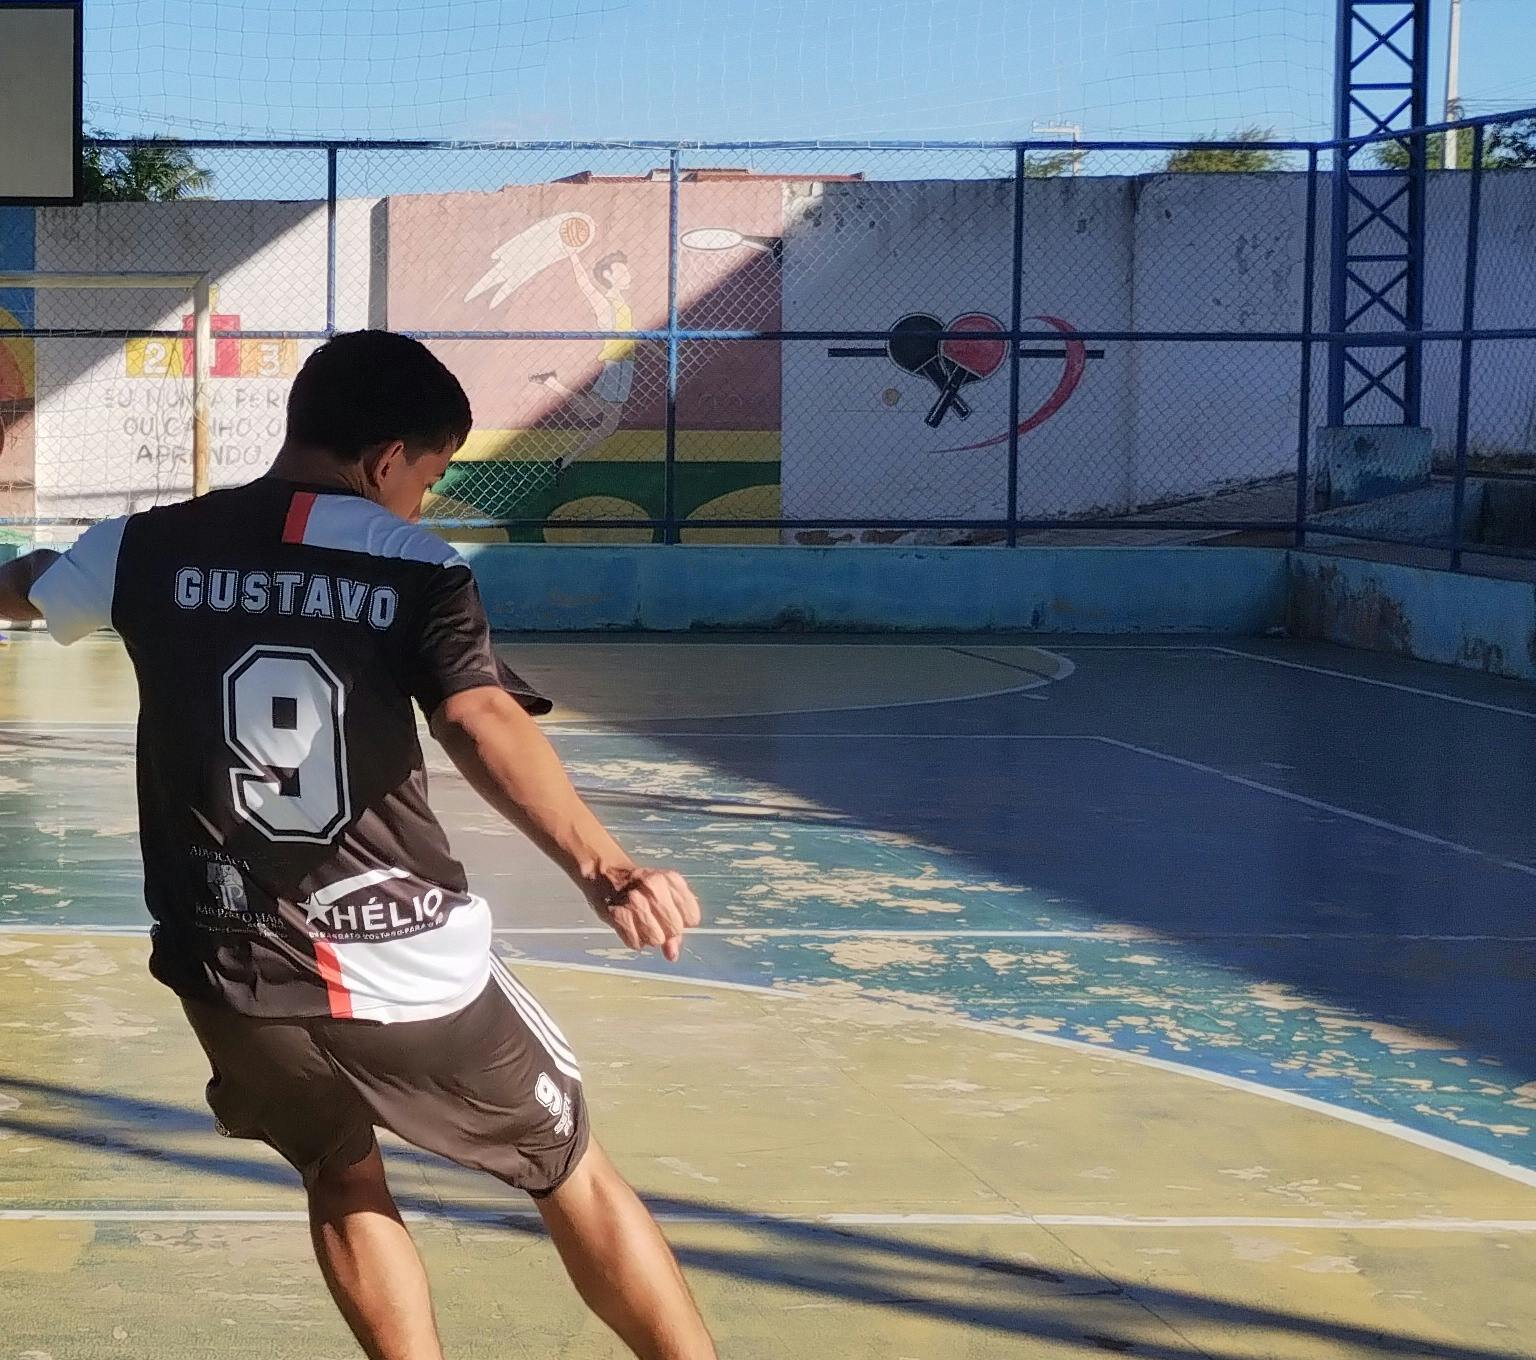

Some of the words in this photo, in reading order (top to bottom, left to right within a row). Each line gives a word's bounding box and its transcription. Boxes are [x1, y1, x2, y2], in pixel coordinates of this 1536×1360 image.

[144, 342, 168, 374] 2
[257, 342, 281, 377] 3
[105, 389, 132, 408] EU
[147, 389, 222, 408] NUNA
[123, 417, 154, 436] OU
[137, 444, 270, 466] APRNDO.
[174, 566, 399, 630] GUSTAVO
[222, 644, 352, 845] 9
[332, 888, 443, 931] HÉLIO
[534, 1071, 562, 1116] 9
